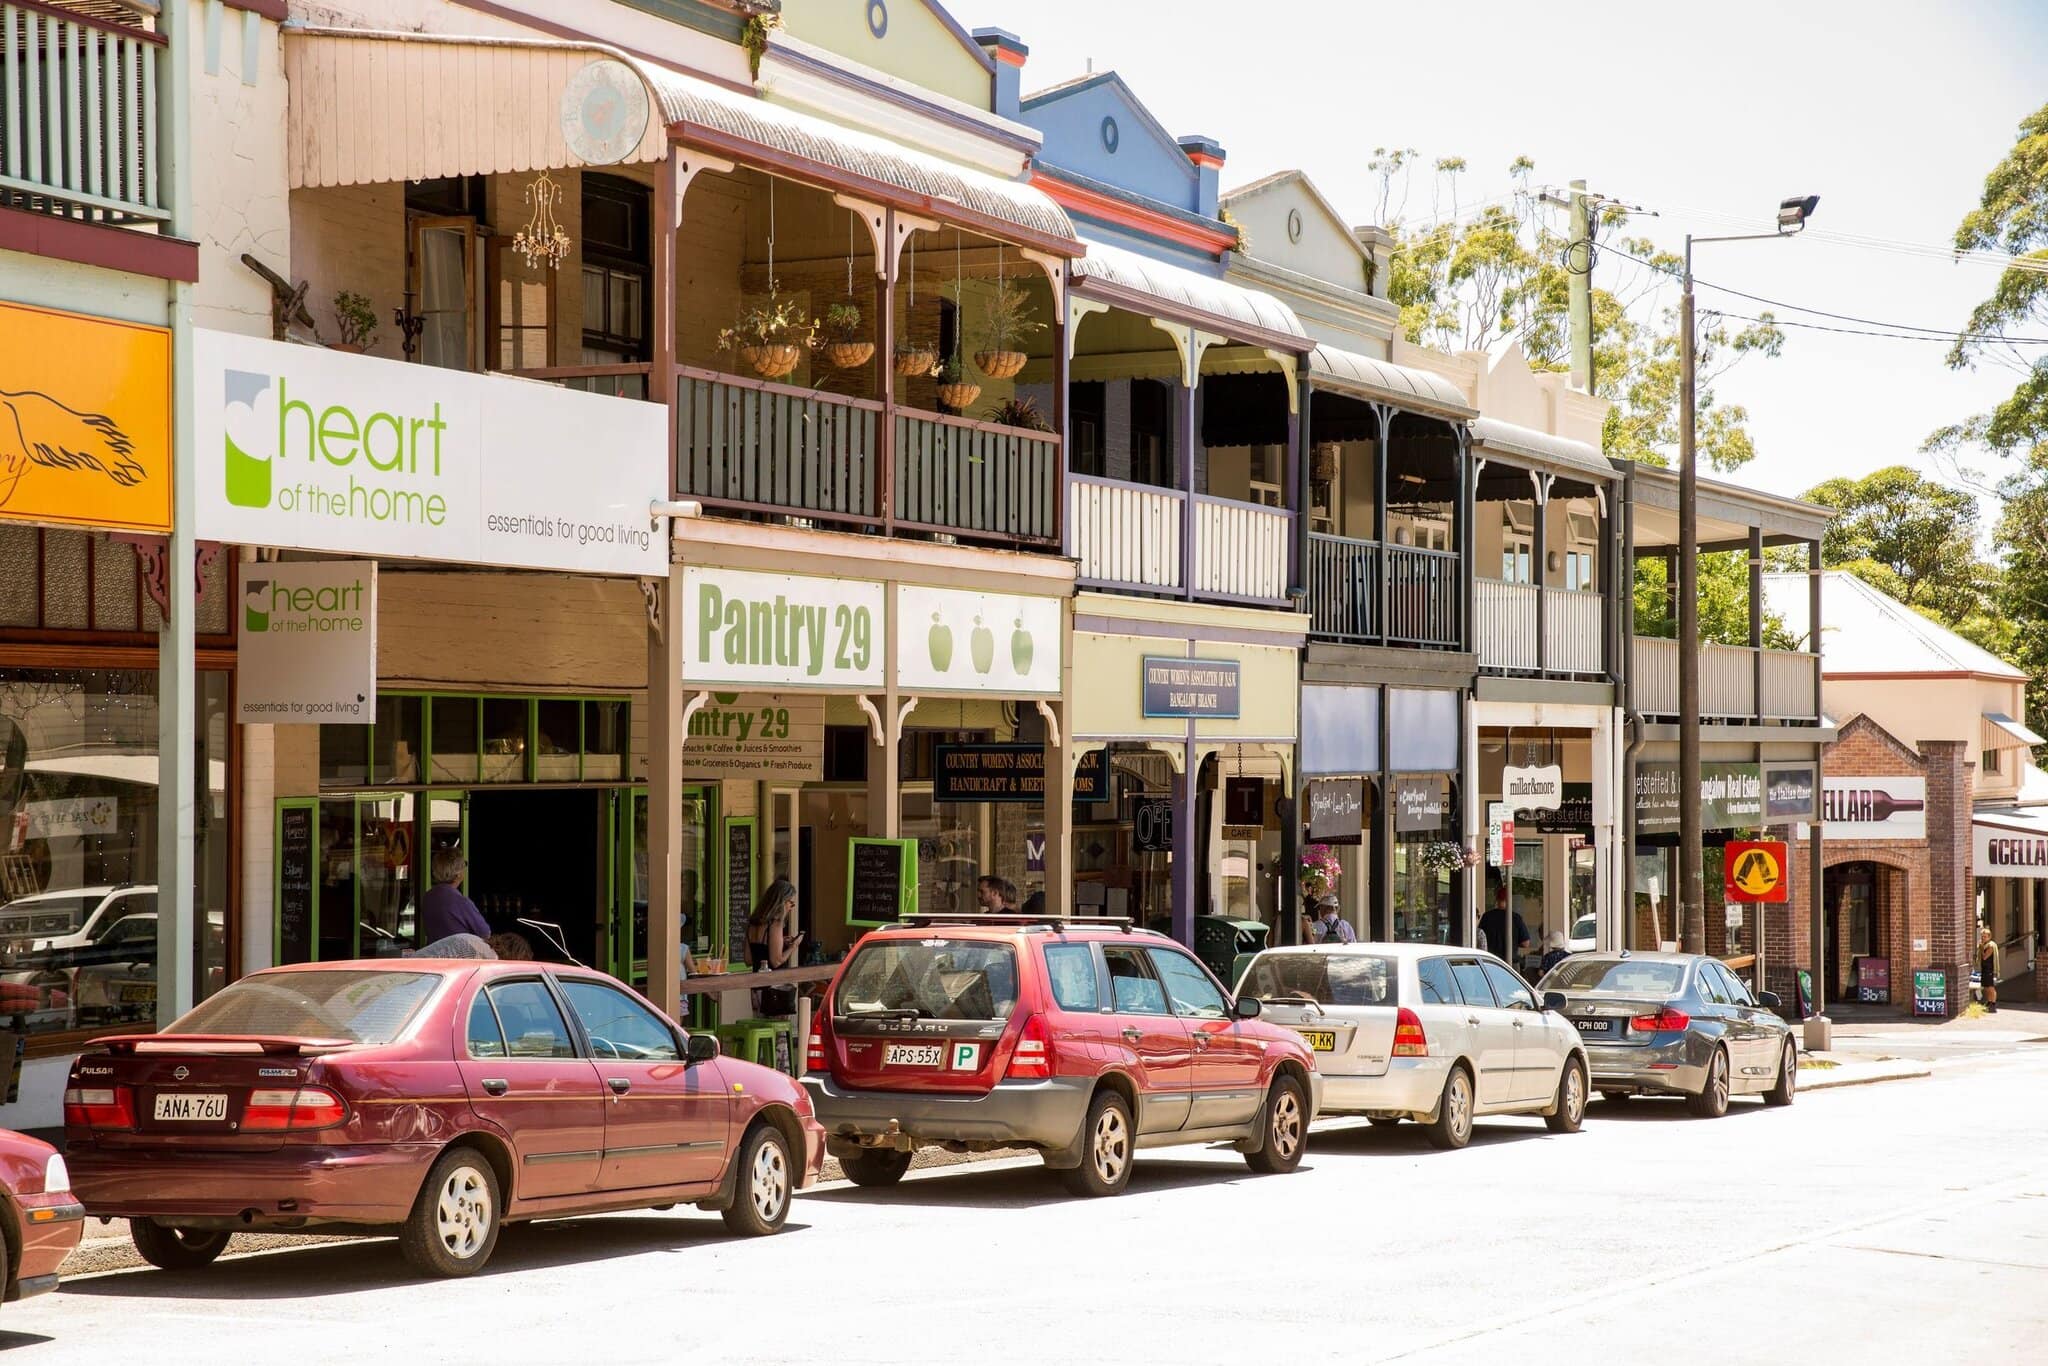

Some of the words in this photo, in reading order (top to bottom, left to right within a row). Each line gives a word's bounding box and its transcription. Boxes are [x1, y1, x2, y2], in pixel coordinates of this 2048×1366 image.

[279, 376, 447, 477] heart
[278, 483, 303, 512] of
[487, 514, 553, 538] essentials
[557, 518, 575, 539] for
[578, 524, 614, 545] good
[618, 524, 649, 551] living
[272, 579, 364, 612] heart
[272, 620, 285, 632] of
[698, 583, 827, 676] Pantry
[834, 604, 871, 671] 29
[243, 701, 289, 713] essentials
[291, 701, 303, 712] for
[306, 701, 333, 714] good
[335, 701, 360, 715] living
[760, 707, 789, 738] 29
[713, 744, 733, 753] Coffee
[743, 744, 762, 753] Juices
[769, 744, 802, 753] Smoothies
[735, 760, 761, 770] Organics
[770, 760, 787, 769] Fresh
[787, 761, 813, 769] Produce
[945, 753, 979, 769] COUNTRY
[981, 753, 1014, 769] WOMEN'S
[1015, 753, 1045, 769] ASSOCIA
[950, 777, 1007, 792] HANDICRAFT
[1009, 777, 1017, 792] &
[1020, 778, 1045, 792] MEET
[1074, 778, 1094, 792] OMS
[1510, 777, 1555, 795] millar&more
[1728, 774, 1741, 799] Real
[1743, 774, 1760, 799] Estate
[1823, 789, 1873, 822] ELLAR
[1230, 829, 1252, 838] CAFE
[1998, 838, 2048, 867] CELLA
[878, 1023, 949, 1032] SUBARU
[958, 1046, 974, 1067] P
[81, 1066, 114, 1075] PULSAR
